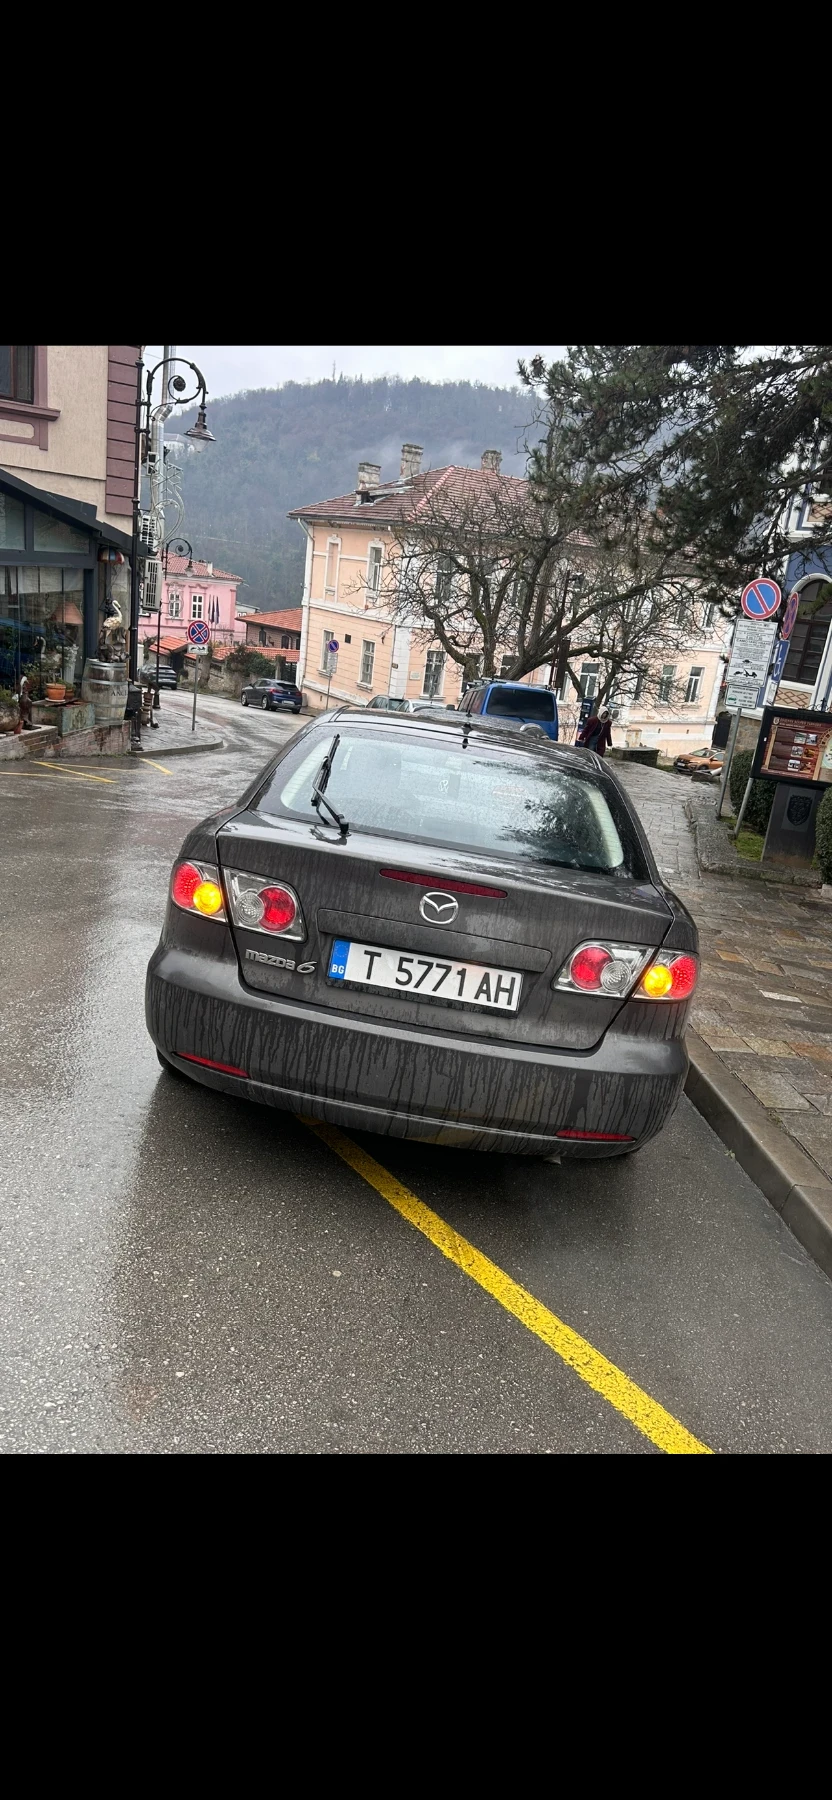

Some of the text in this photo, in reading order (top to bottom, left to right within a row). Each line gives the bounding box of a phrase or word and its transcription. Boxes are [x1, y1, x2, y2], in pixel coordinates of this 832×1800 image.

[296, 961, 318, 974] 6
[331, 964, 345, 975] BG
[363, 949, 516, 1006] T 5771 AH
